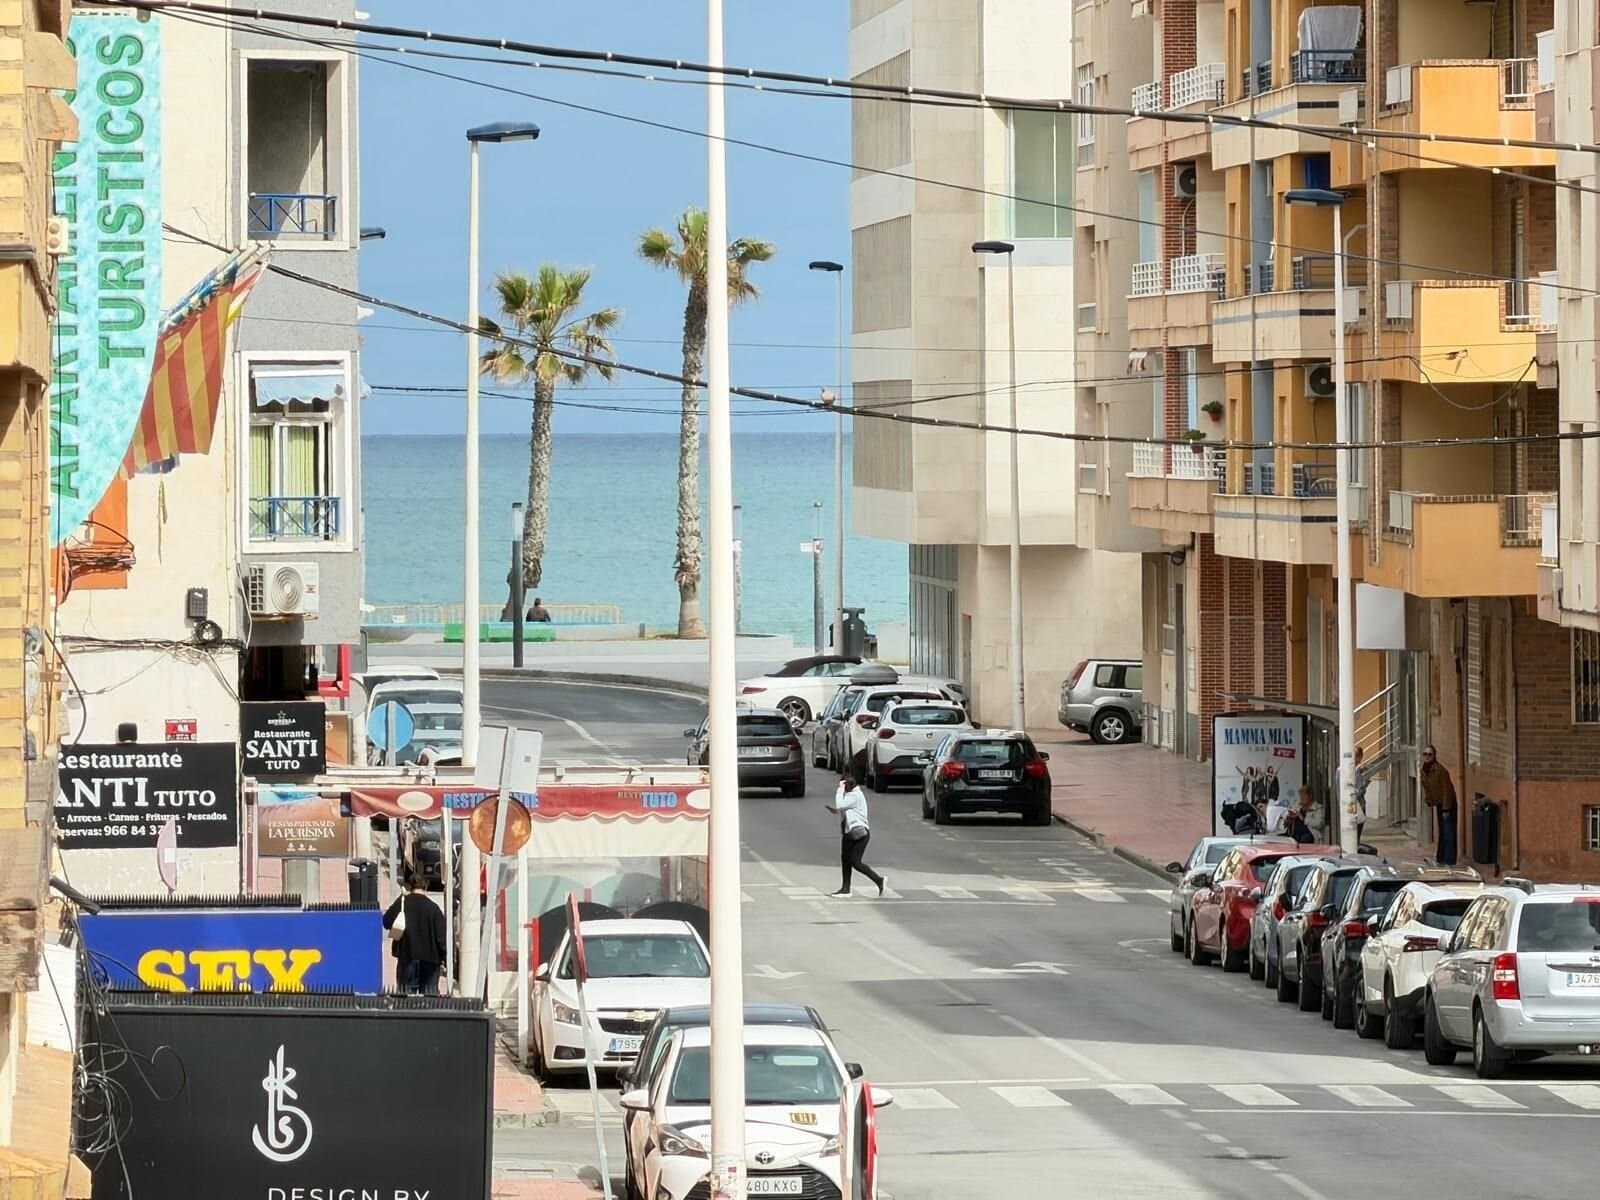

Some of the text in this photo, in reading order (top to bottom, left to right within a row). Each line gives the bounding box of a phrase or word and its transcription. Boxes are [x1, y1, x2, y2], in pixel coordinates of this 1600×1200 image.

[95, 34, 145, 369] TURISTICOS
[254, 730, 311, 738] Restaurante
[1224, 727, 1293, 745] MAMMA MIA!
[246, 739, 318, 758] SANTI
[265, 759, 300, 770] TUTO
[55, 777, 216, 808] ANTI TUTO
[641, 791, 678, 808] TUTO
[67, 811, 228, 823] Arroces Carnes Frituras Pescados
[63, 828, 102, 837] servas:
[103, 825, 128, 836] 966
[131, 825, 146, 836] 84
[268, 827, 283, 839] LA
[746, 1180, 798, 1192] 480 KXG
[268, 1187, 378, 1200] DESIGN
